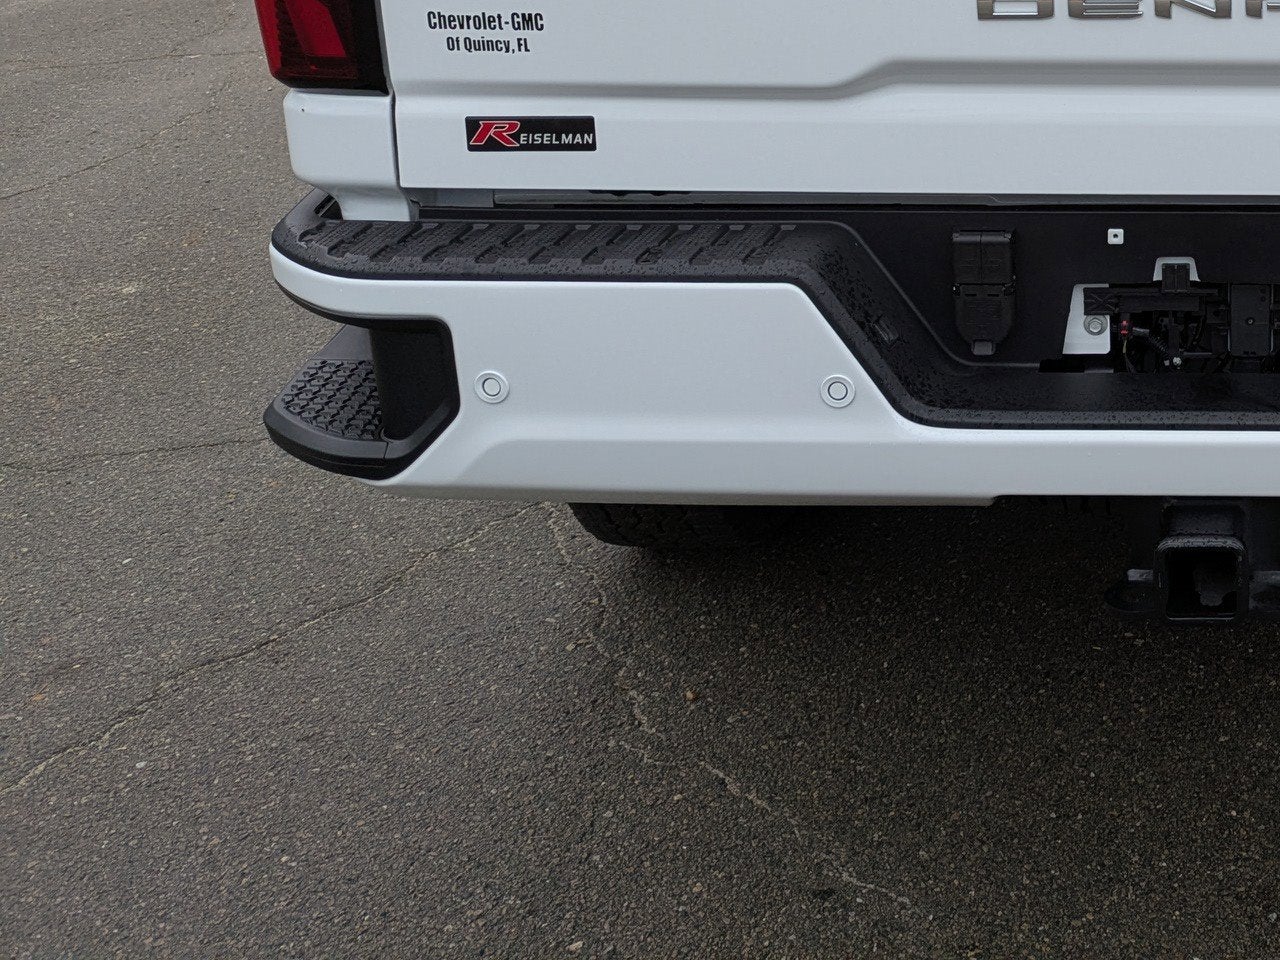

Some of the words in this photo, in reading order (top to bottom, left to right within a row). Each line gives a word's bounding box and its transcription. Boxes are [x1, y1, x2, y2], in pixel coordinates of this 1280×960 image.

[427, 10, 545, 31] Chevrolet-GMC
[446, 36, 461, 52] Of
[463, 36, 515, 54] Quincy,
[517, 38, 530, 52] FL
